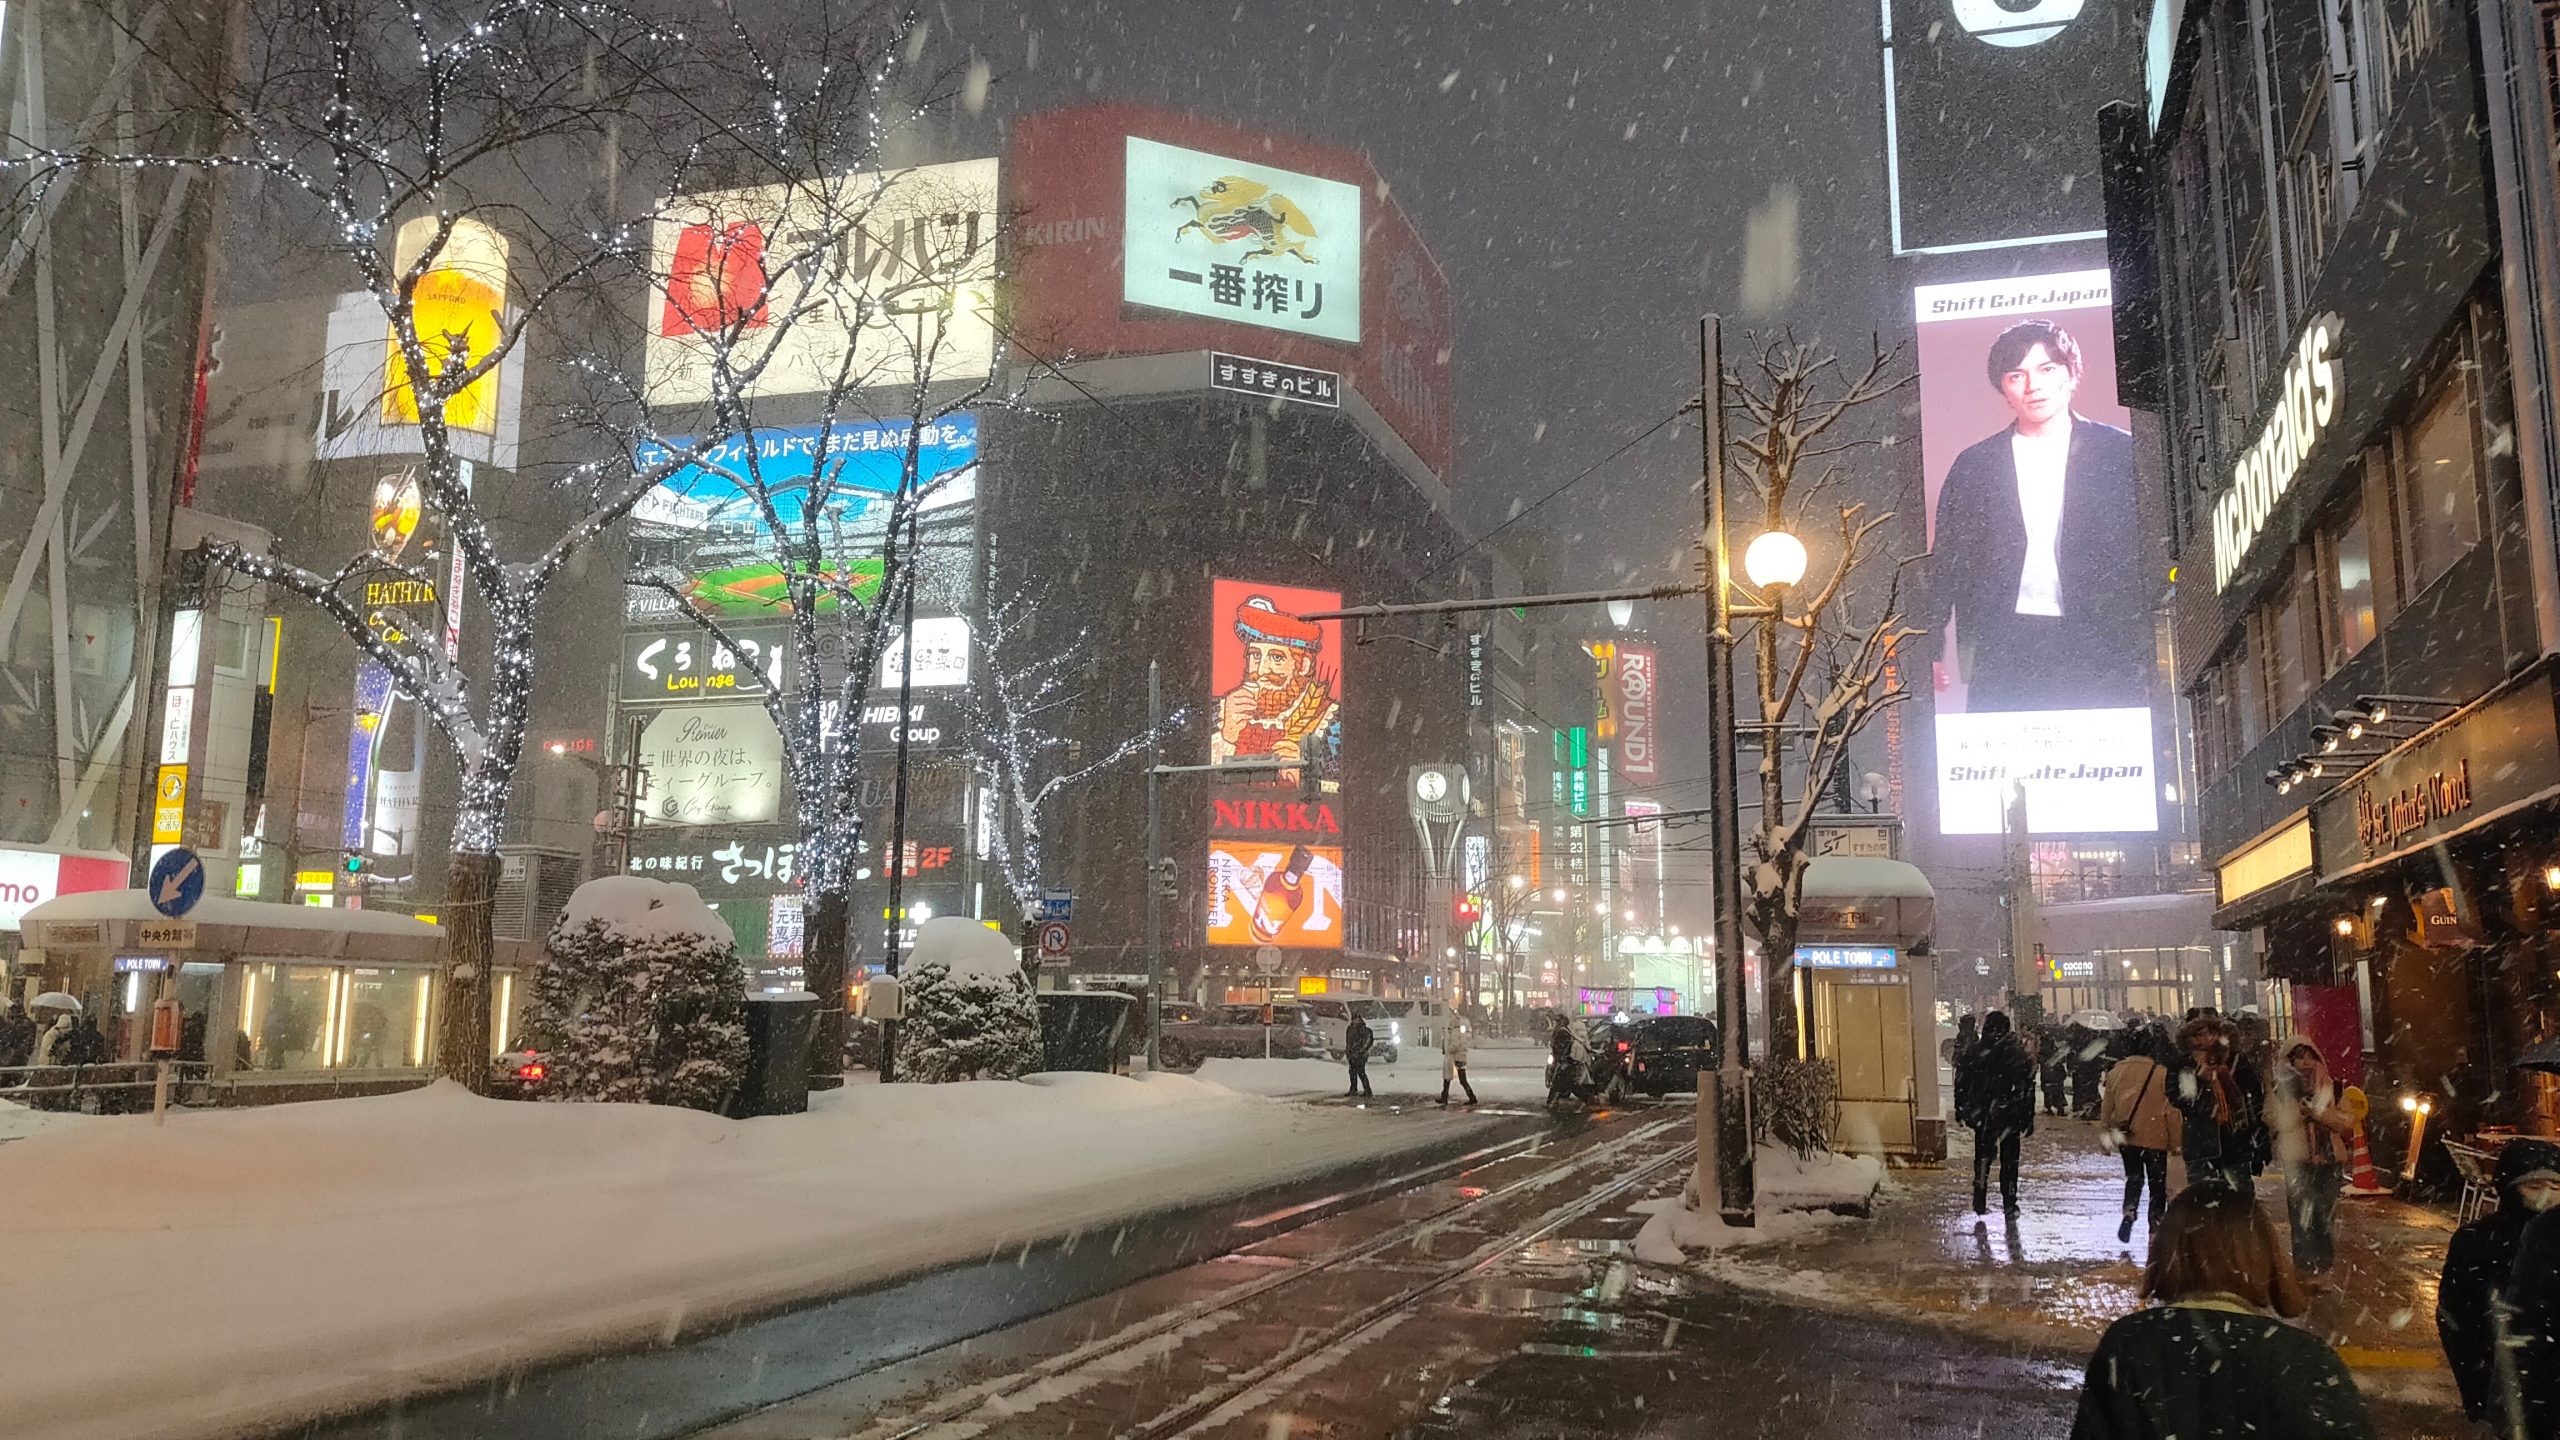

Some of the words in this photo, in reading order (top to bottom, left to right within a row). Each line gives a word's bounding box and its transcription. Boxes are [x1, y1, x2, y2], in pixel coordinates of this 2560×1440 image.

[1022, 217, 1107, 246] KIRIN
[426, 293, 466, 304] SAPPORO
[1168, 262, 1323, 320] 一番搾り
[1931, 296, 1986, 315] Shift
[1989, 292, 2039, 310] Gate
[2041, 287, 2108, 307] Japan
[1219, 363, 1332, 399] すすきのビル
[2212, 325, 2334, 597] McDonald's
[661, 498, 705, 520] FIGHTERS
[366, 580, 435, 605] HATHYR
[667, 673, 735, 690] Lounge
[863, 705, 925, 723] HIBKI
[1620, 652, 1654, 774] ROUND1
[167, 695, 182, 761] ほっとハウス
[675, 716, 728, 743] Premier
[2069, 763, 2143, 782] Japan
[1212, 799, 1341, 834] NIKKA
[2389, 783, 2427, 850] John's
[629, 855, 704, 871] 北の味紀行
[921, 848, 952, 869] 2F
[126, 958, 144, 970] POLE
[1811, 951, 1841, 965] POLE
[1843, 951, 1873, 965] TOWN
